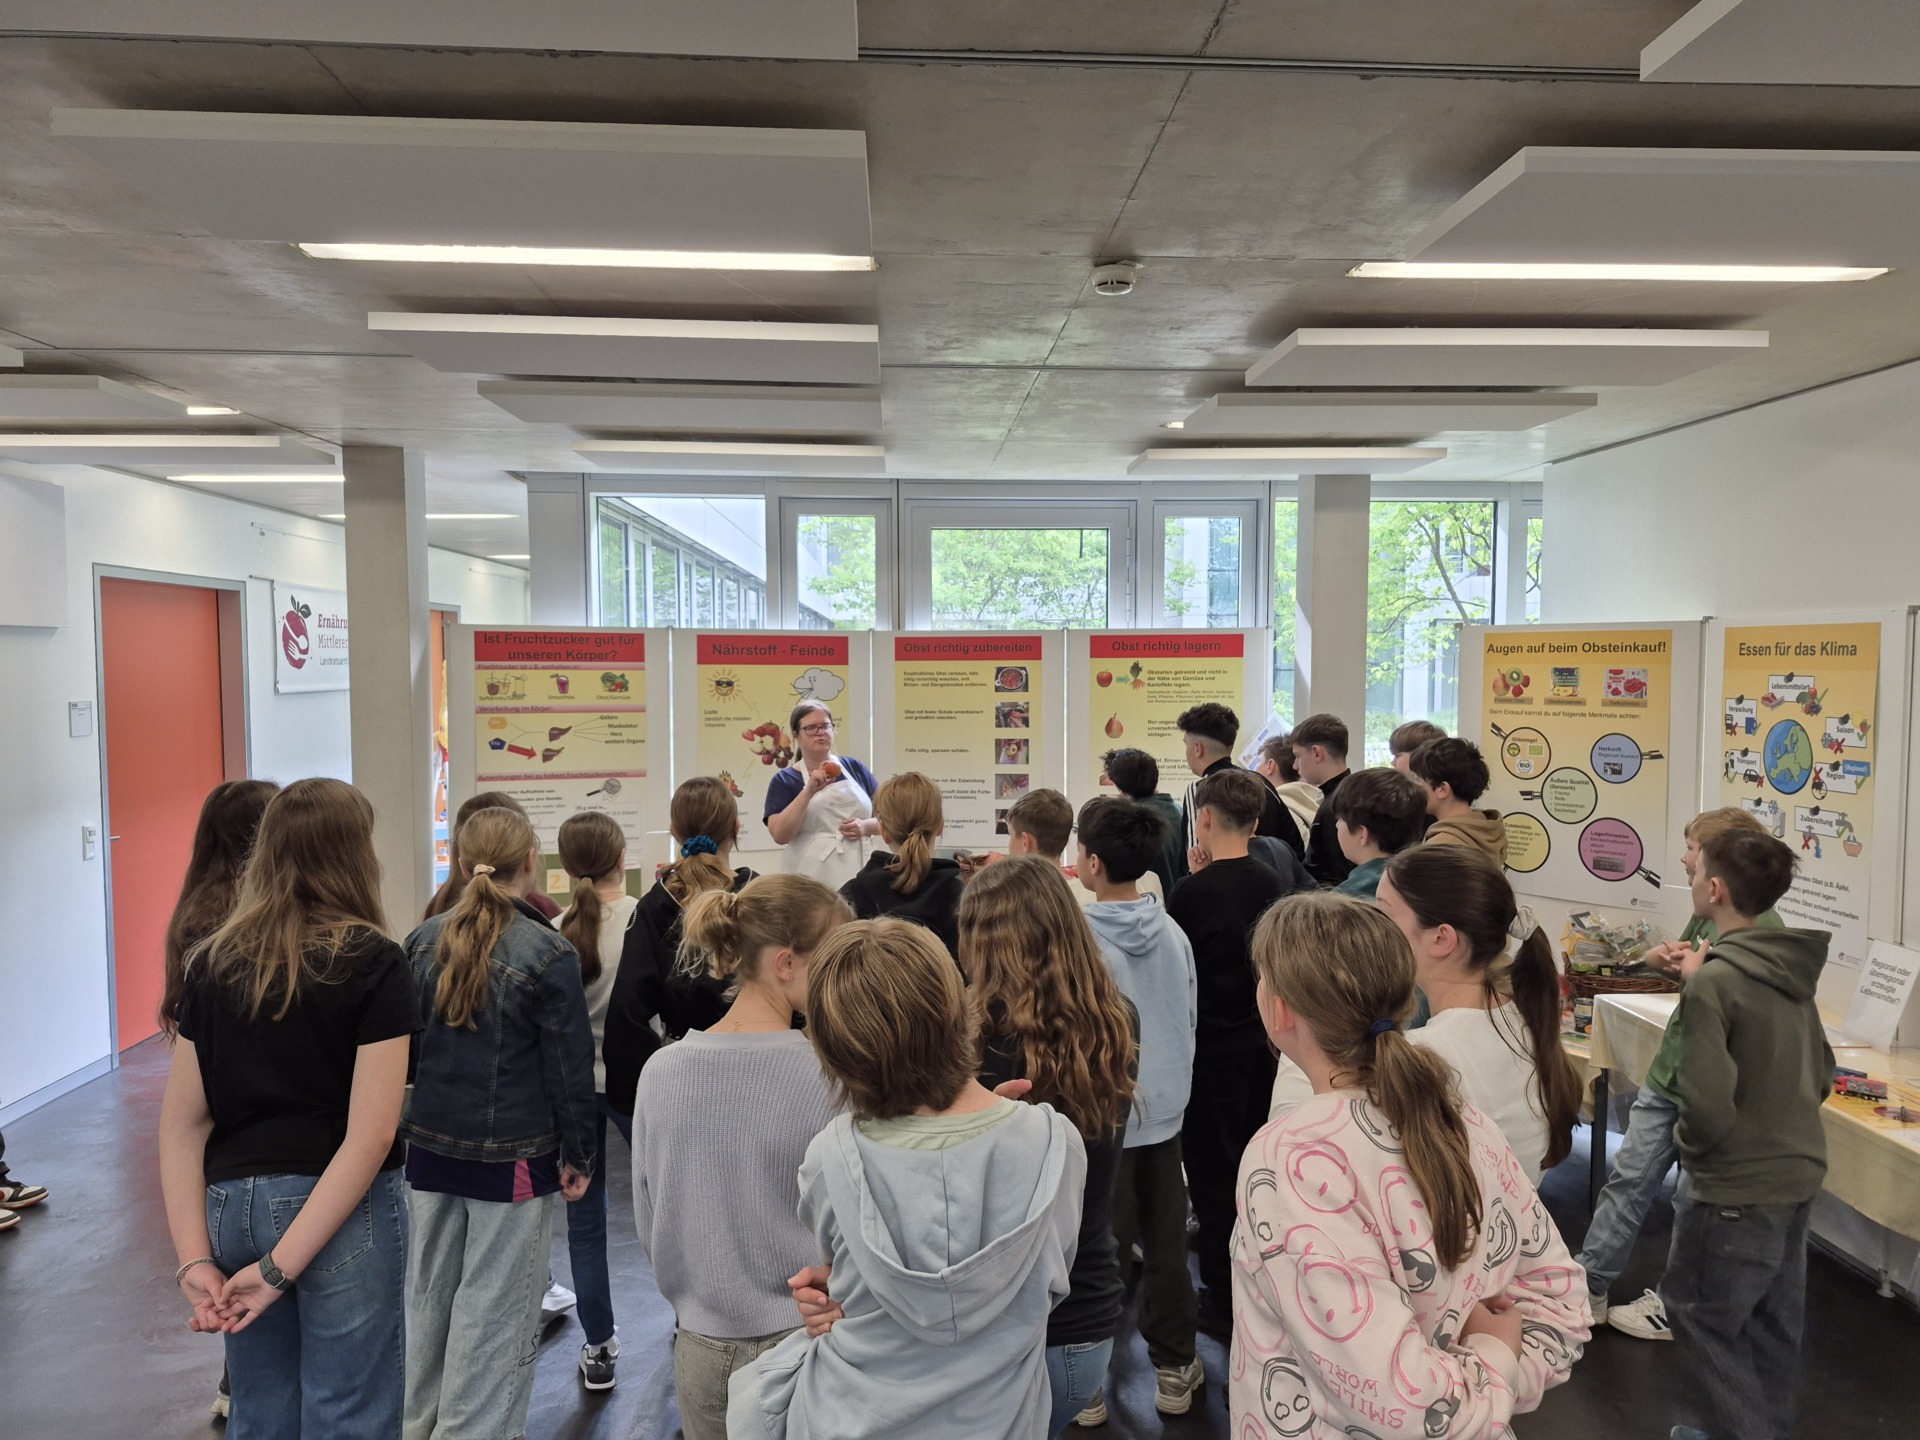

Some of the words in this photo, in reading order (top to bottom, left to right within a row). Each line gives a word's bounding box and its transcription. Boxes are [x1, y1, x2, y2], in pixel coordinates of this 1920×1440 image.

[318, 613, 348, 629] Ernähru
[484, 633, 500, 645] Ist
[504, 633, 591, 646] Fruchtzucker
[594, 636, 615, 648] gut
[618, 635, 637, 646] für
[1111, 641, 1140, 651] Obst
[1143, 640, 1181, 653] richtig
[1184, 640, 1222, 653] lagern
[712, 643, 778, 656] Nährstoff
[790, 644, 835, 656] Feinde
[904, 643, 930, 653] Obst
[934, 643, 970, 655] richtig
[973, 643, 1032, 653] zubereiten
[1487, 643, 1523, 656] Augen
[1526, 643, 1546, 654] auf
[1548, 642, 1578, 653] beim
[1581, 641, 1666, 653] Obsteinkauf!
[1739, 642, 1771, 656] Essen
[1774, 642, 1791, 656] für
[1794, 642, 1816, 656] das
[1820, 641, 1857, 656] Klima
[508, 651, 562, 660] unseren
[566, 649, 618, 662] Körper?
[1771, 682, 1810, 690] Lebensmittelart
[478, 705, 521, 713] Verarbeitung
[1588, 711, 1617, 719] Merkmale
[1728, 705, 1753, 714] Verpackung
[1836, 725, 1854, 734] Saison
[1736, 757, 1757, 766] Transport
[478, 773, 523, 781] Auswirkungen
[1549, 776, 1569, 784] Äußere
[1569, 778, 1590, 786] Qualität
[1826, 771, 1846, 781] Region
[1549, 784, 1576, 792] (Sensorik)
[1800, 814, 1833, 827] Zubereitung
[1590, 830, 1630, 839] Lagerhinweise
[1811, 877, 1824, 885] Obst
[1801, 888, 1822, 898] getrennt
[1801, 899, 1813, 909] Obst
[1813, 902, 1831, 913] schnell
[1830, 908, 1860, 920] verarbeiten
[1824, 919, 1842, 929] nutzen
[1871, 957, 1898, 973] Regional
[1896, 967, 1912, 977] oder
[1869, 969, 1906, 986] überregional
[1860, 985, 1901, 1005] Lebensmittel?
[1309, 1350, 1380, 1398] WORLD
[1330, 1379, 1407, 1430] SMILE
